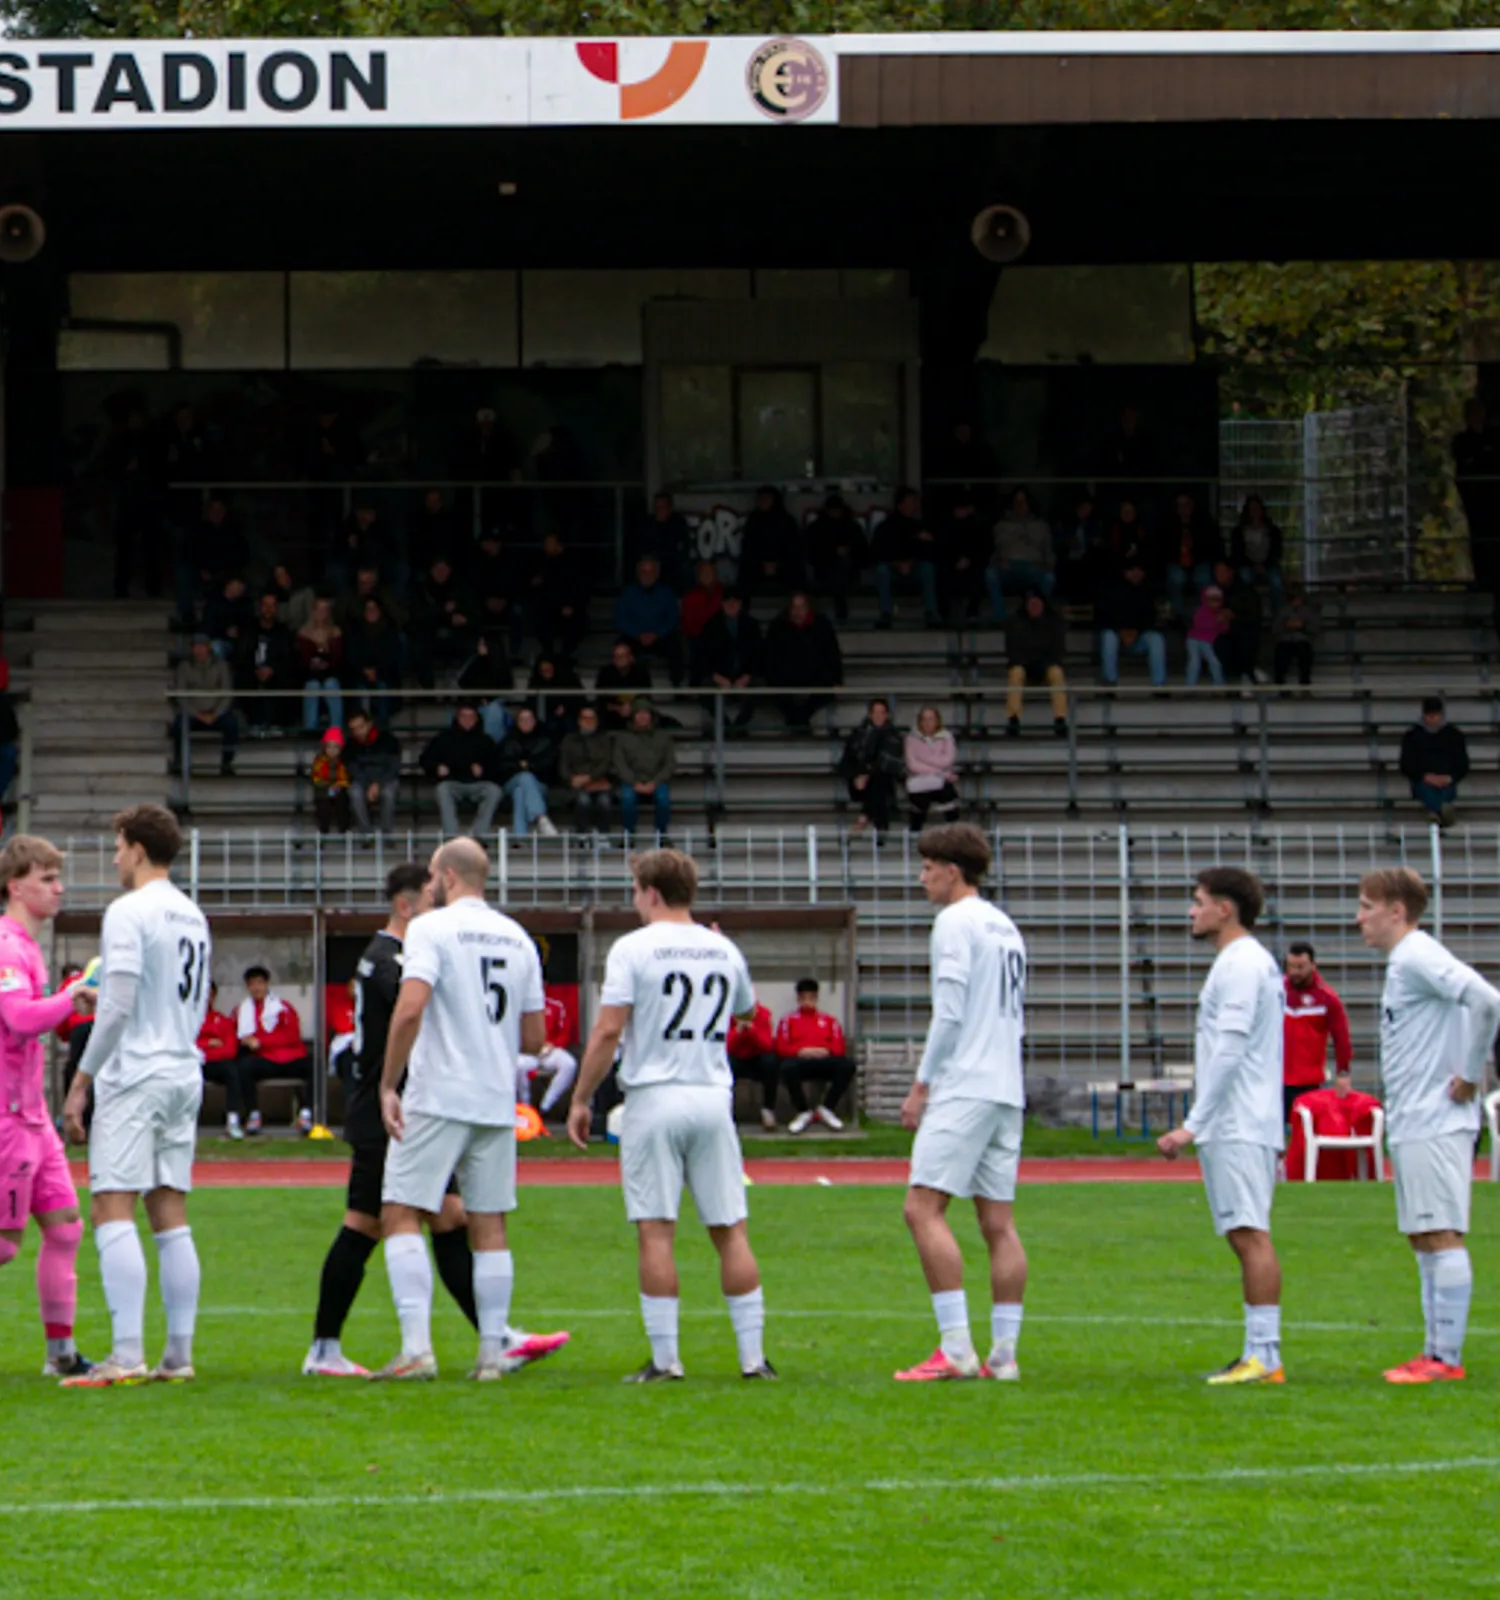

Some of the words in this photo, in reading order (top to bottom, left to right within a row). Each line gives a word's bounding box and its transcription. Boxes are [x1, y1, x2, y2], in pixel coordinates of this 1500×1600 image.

[480, 955, 508, 1025] 5
[663, 970, 729, 1041] 22
[8, 1189, 17, 1219] 1
